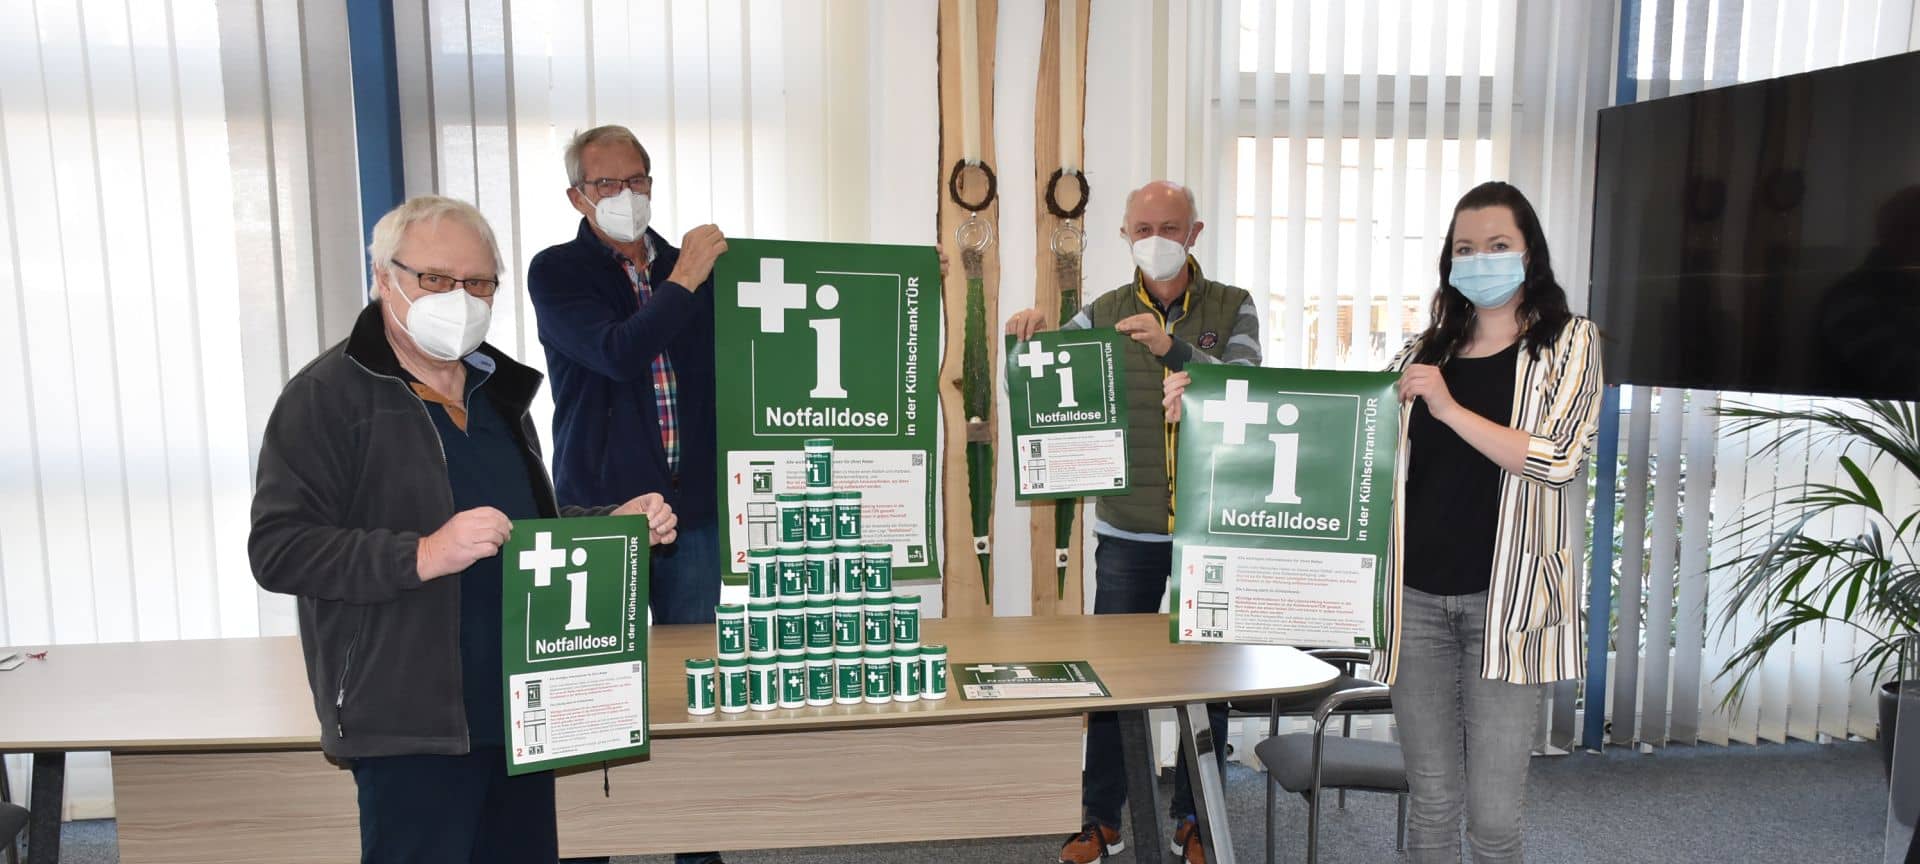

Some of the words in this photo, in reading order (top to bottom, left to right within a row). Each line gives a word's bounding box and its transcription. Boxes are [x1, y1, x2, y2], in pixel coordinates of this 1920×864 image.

[905, 276, 919, 394] KühlschrankTÜR
[766, 407, 889, 428] Notfalldose
[905, 398, 917, 420] der
[1036, 410, 1102, 424] Notfalldose
[905, 424, 916, 436] in
[1359, 397, 1379, 503] KühlschrankTÜR
[734, 473, 742, 485] 1
[735, 513, 744, 526] 1
[1221, 509, 1341, 532] Notfalldose
[1357, 506, 1369, 526] der
[1356, 531, 1368, 542] in
[736, 551, 746, 563] 2
[627, 536, 639, 621] KühlschrankTÜR
[627, 624, 636, 640] der
[535, 634, 617, 655] Notfalldose
[627, 641, 636, 652] in
